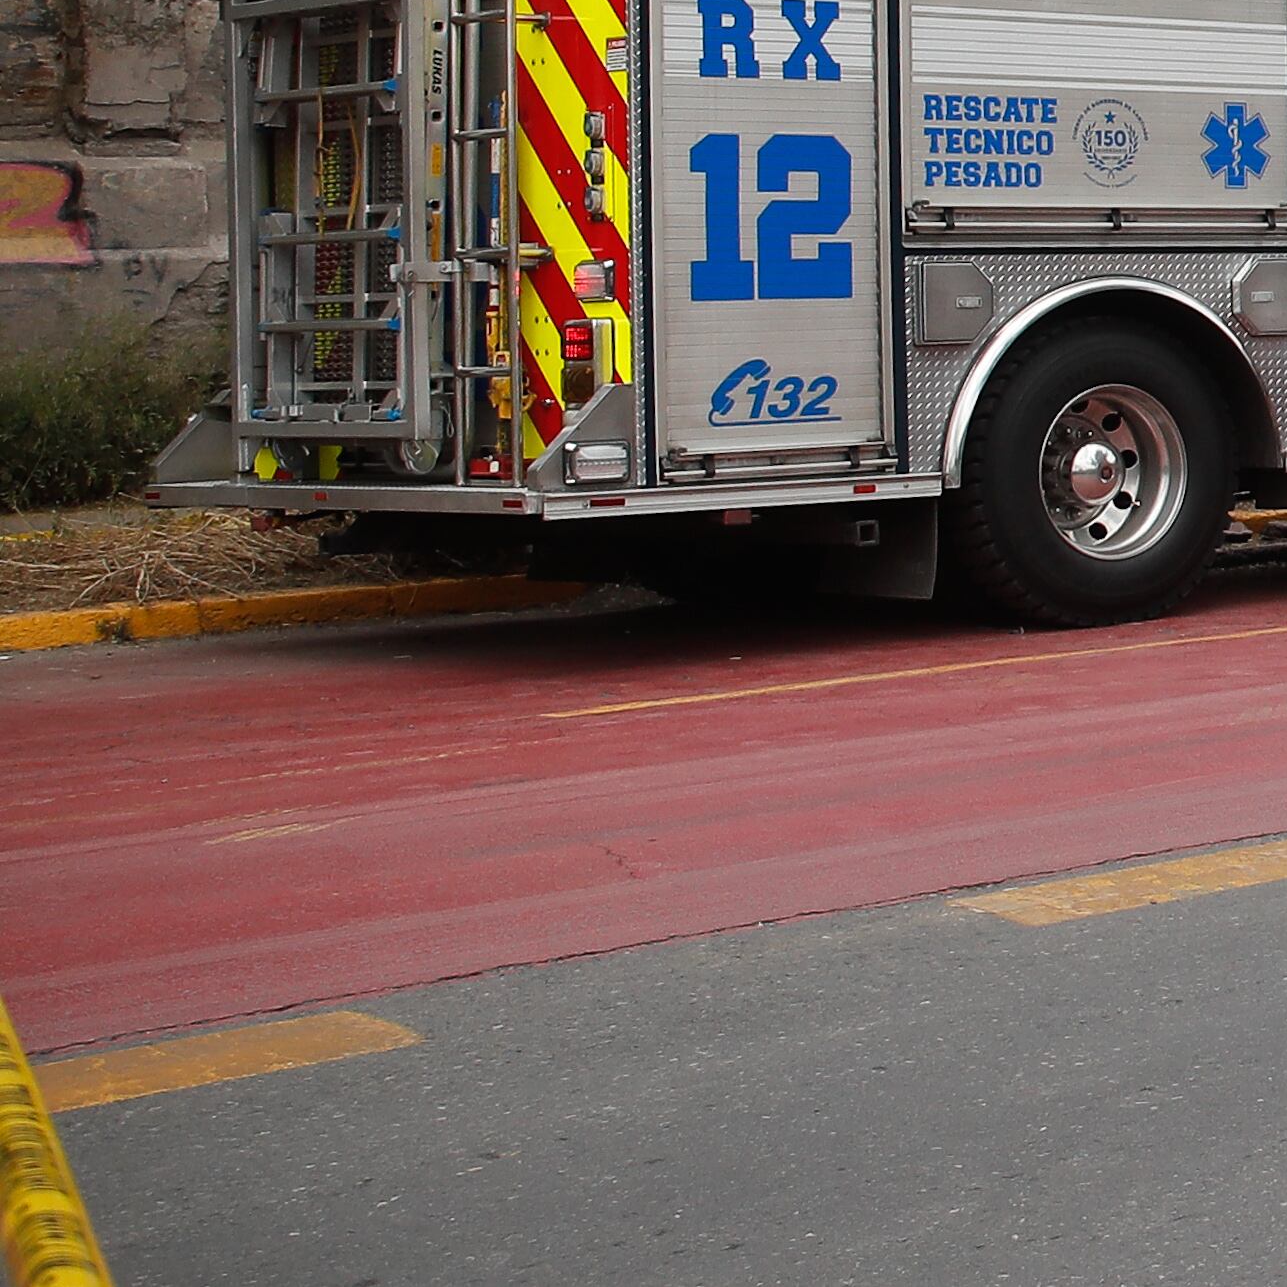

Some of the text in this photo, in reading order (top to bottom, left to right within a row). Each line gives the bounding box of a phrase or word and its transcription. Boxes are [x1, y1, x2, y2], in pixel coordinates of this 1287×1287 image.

[432, 48, 444, 95] LUKAS
[923, 94, 1057, 123] RESCATE
[924, 127, 1054, 155] TECNICO
[1095, 129, 1127, 147] 150
[924, 161, 1042, 187] PESADO
[690, 133, 853, 302] 12
[746, 376, 838, 419] 132
